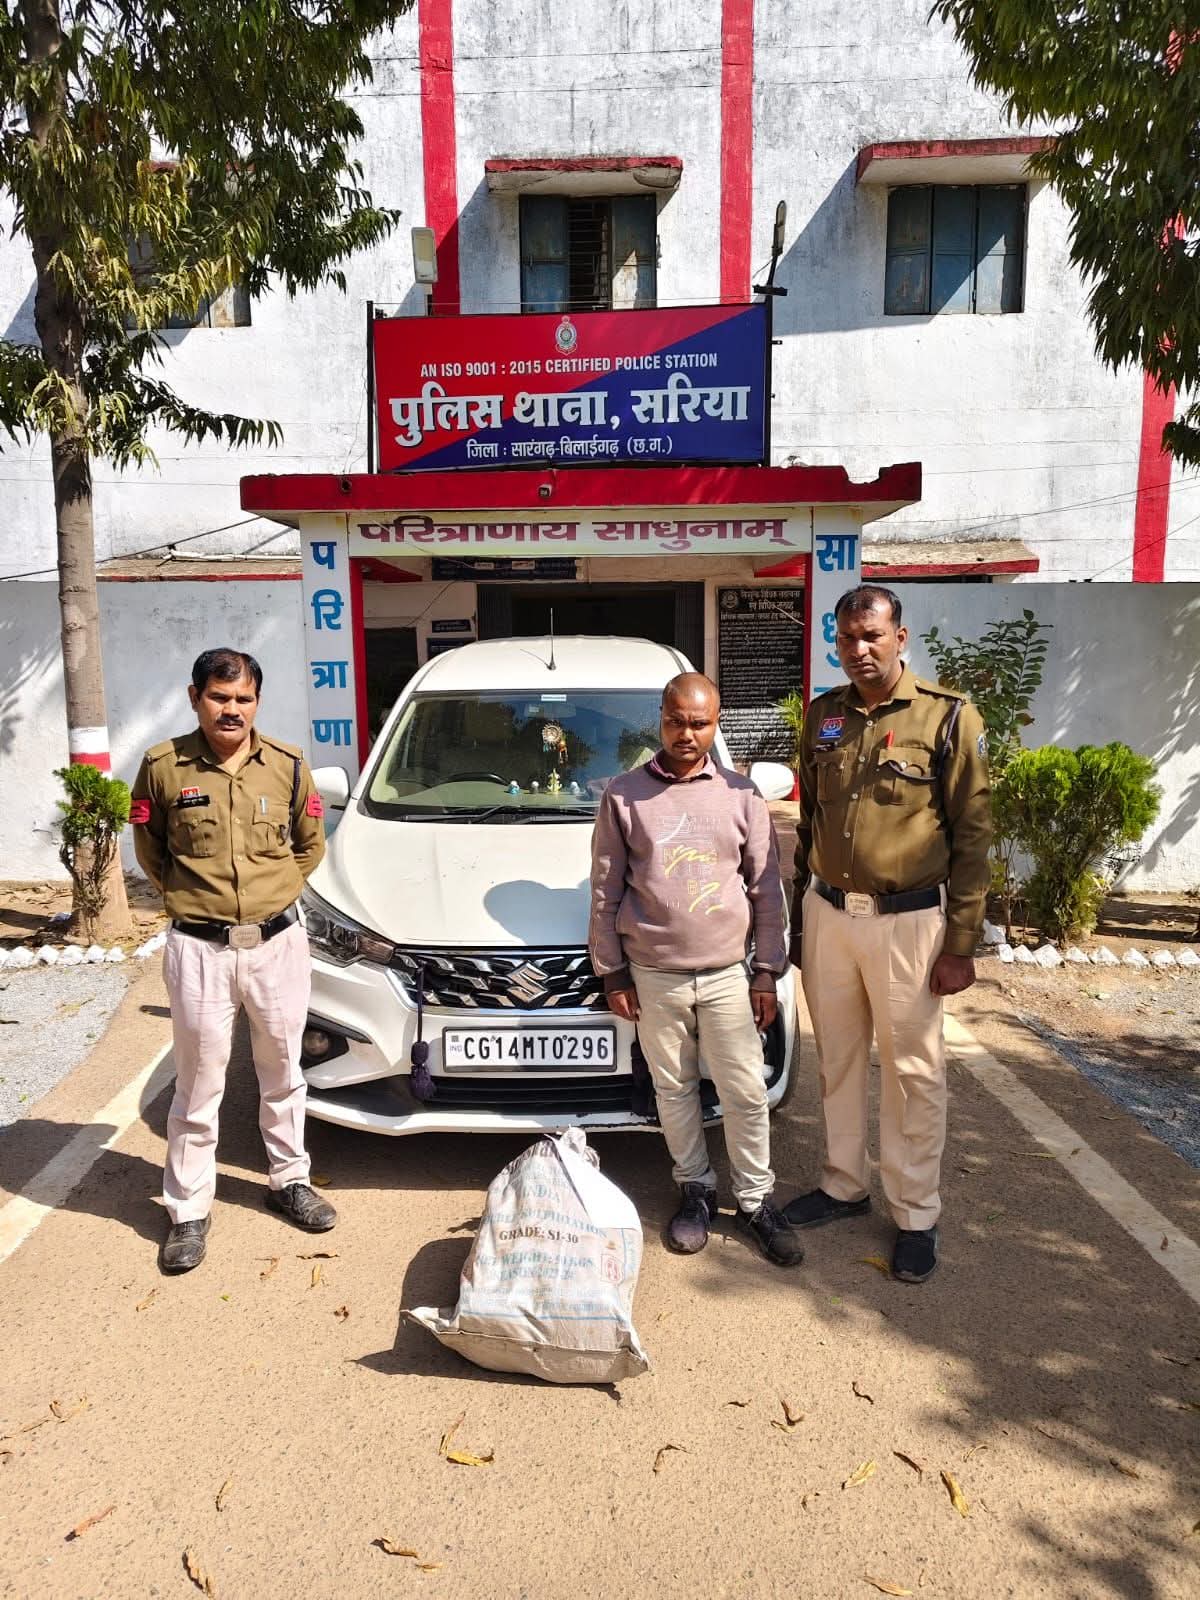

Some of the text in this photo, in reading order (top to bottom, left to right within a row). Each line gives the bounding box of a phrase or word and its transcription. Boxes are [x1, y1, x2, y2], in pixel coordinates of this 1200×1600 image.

[421, 364, 438, 377] AN
[441, 363, 462, 377] ISO
[466, 362, 496, 376] 9001
[509, 361, 542, 375] 2015
[545, 358, 611, 374] CERTIFIED
[615, 355, 661, 370] POLICE
[664, 353, 718, 369] STATION
[389, 372, 751, 447] पुलिस थाना, सरिया
[466, 440, 499, 459] जिला
[626, 435, 673, 456] (छ.ग.)
[358, 515, 799, 551] परित्राणाय साधुनाम्
[464, 1036, 608, 1060] CG14MT0296
[499, 1226, 545, 1241] GRADE:
